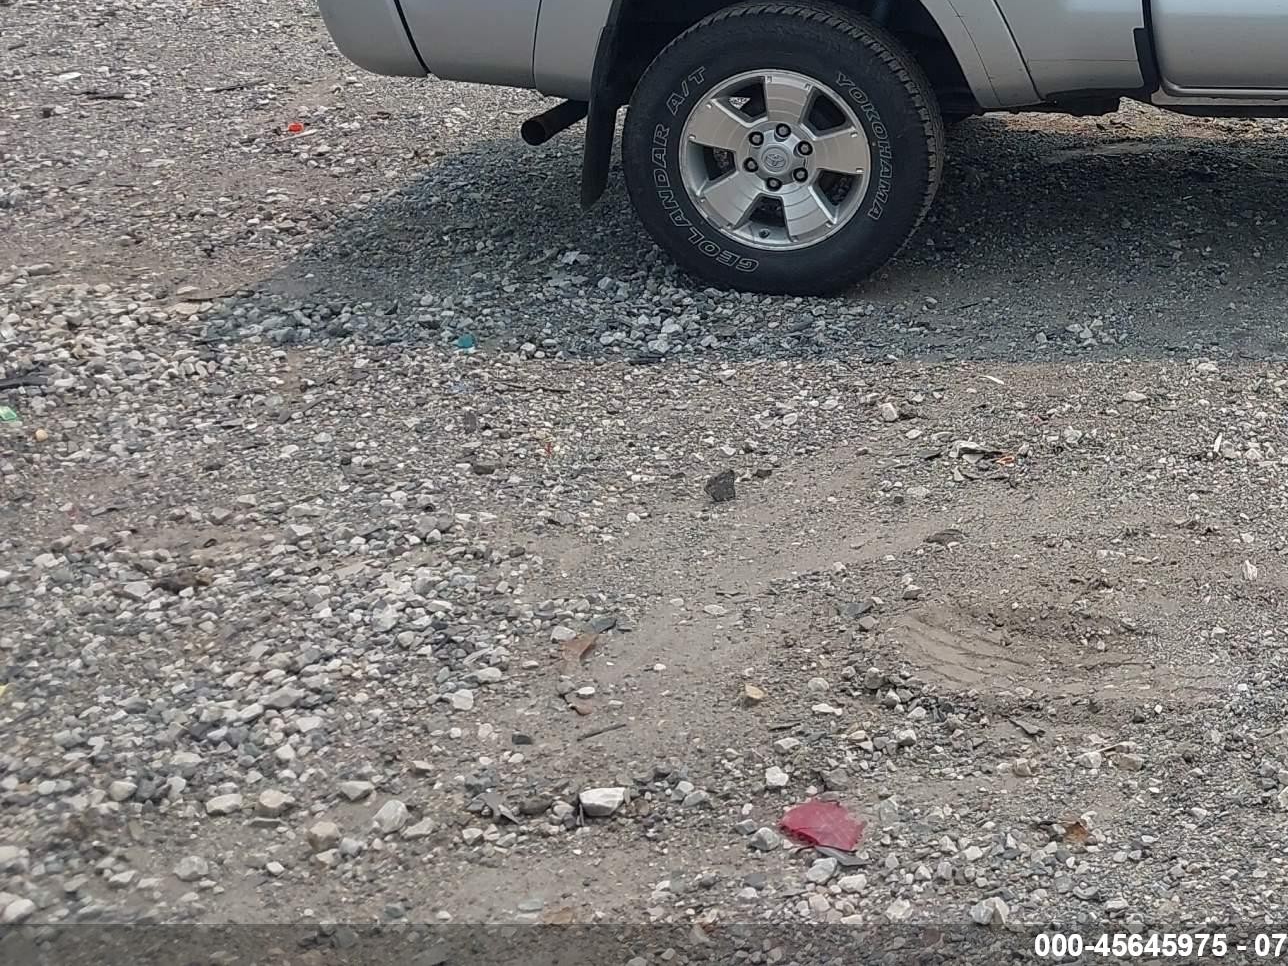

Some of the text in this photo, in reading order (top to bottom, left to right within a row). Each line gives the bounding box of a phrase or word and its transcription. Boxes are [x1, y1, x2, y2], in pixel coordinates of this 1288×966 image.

[652, 65, 760, 273] GEOLANDAR A/T
[835, 70, 893, 221] YOKOHAMA
